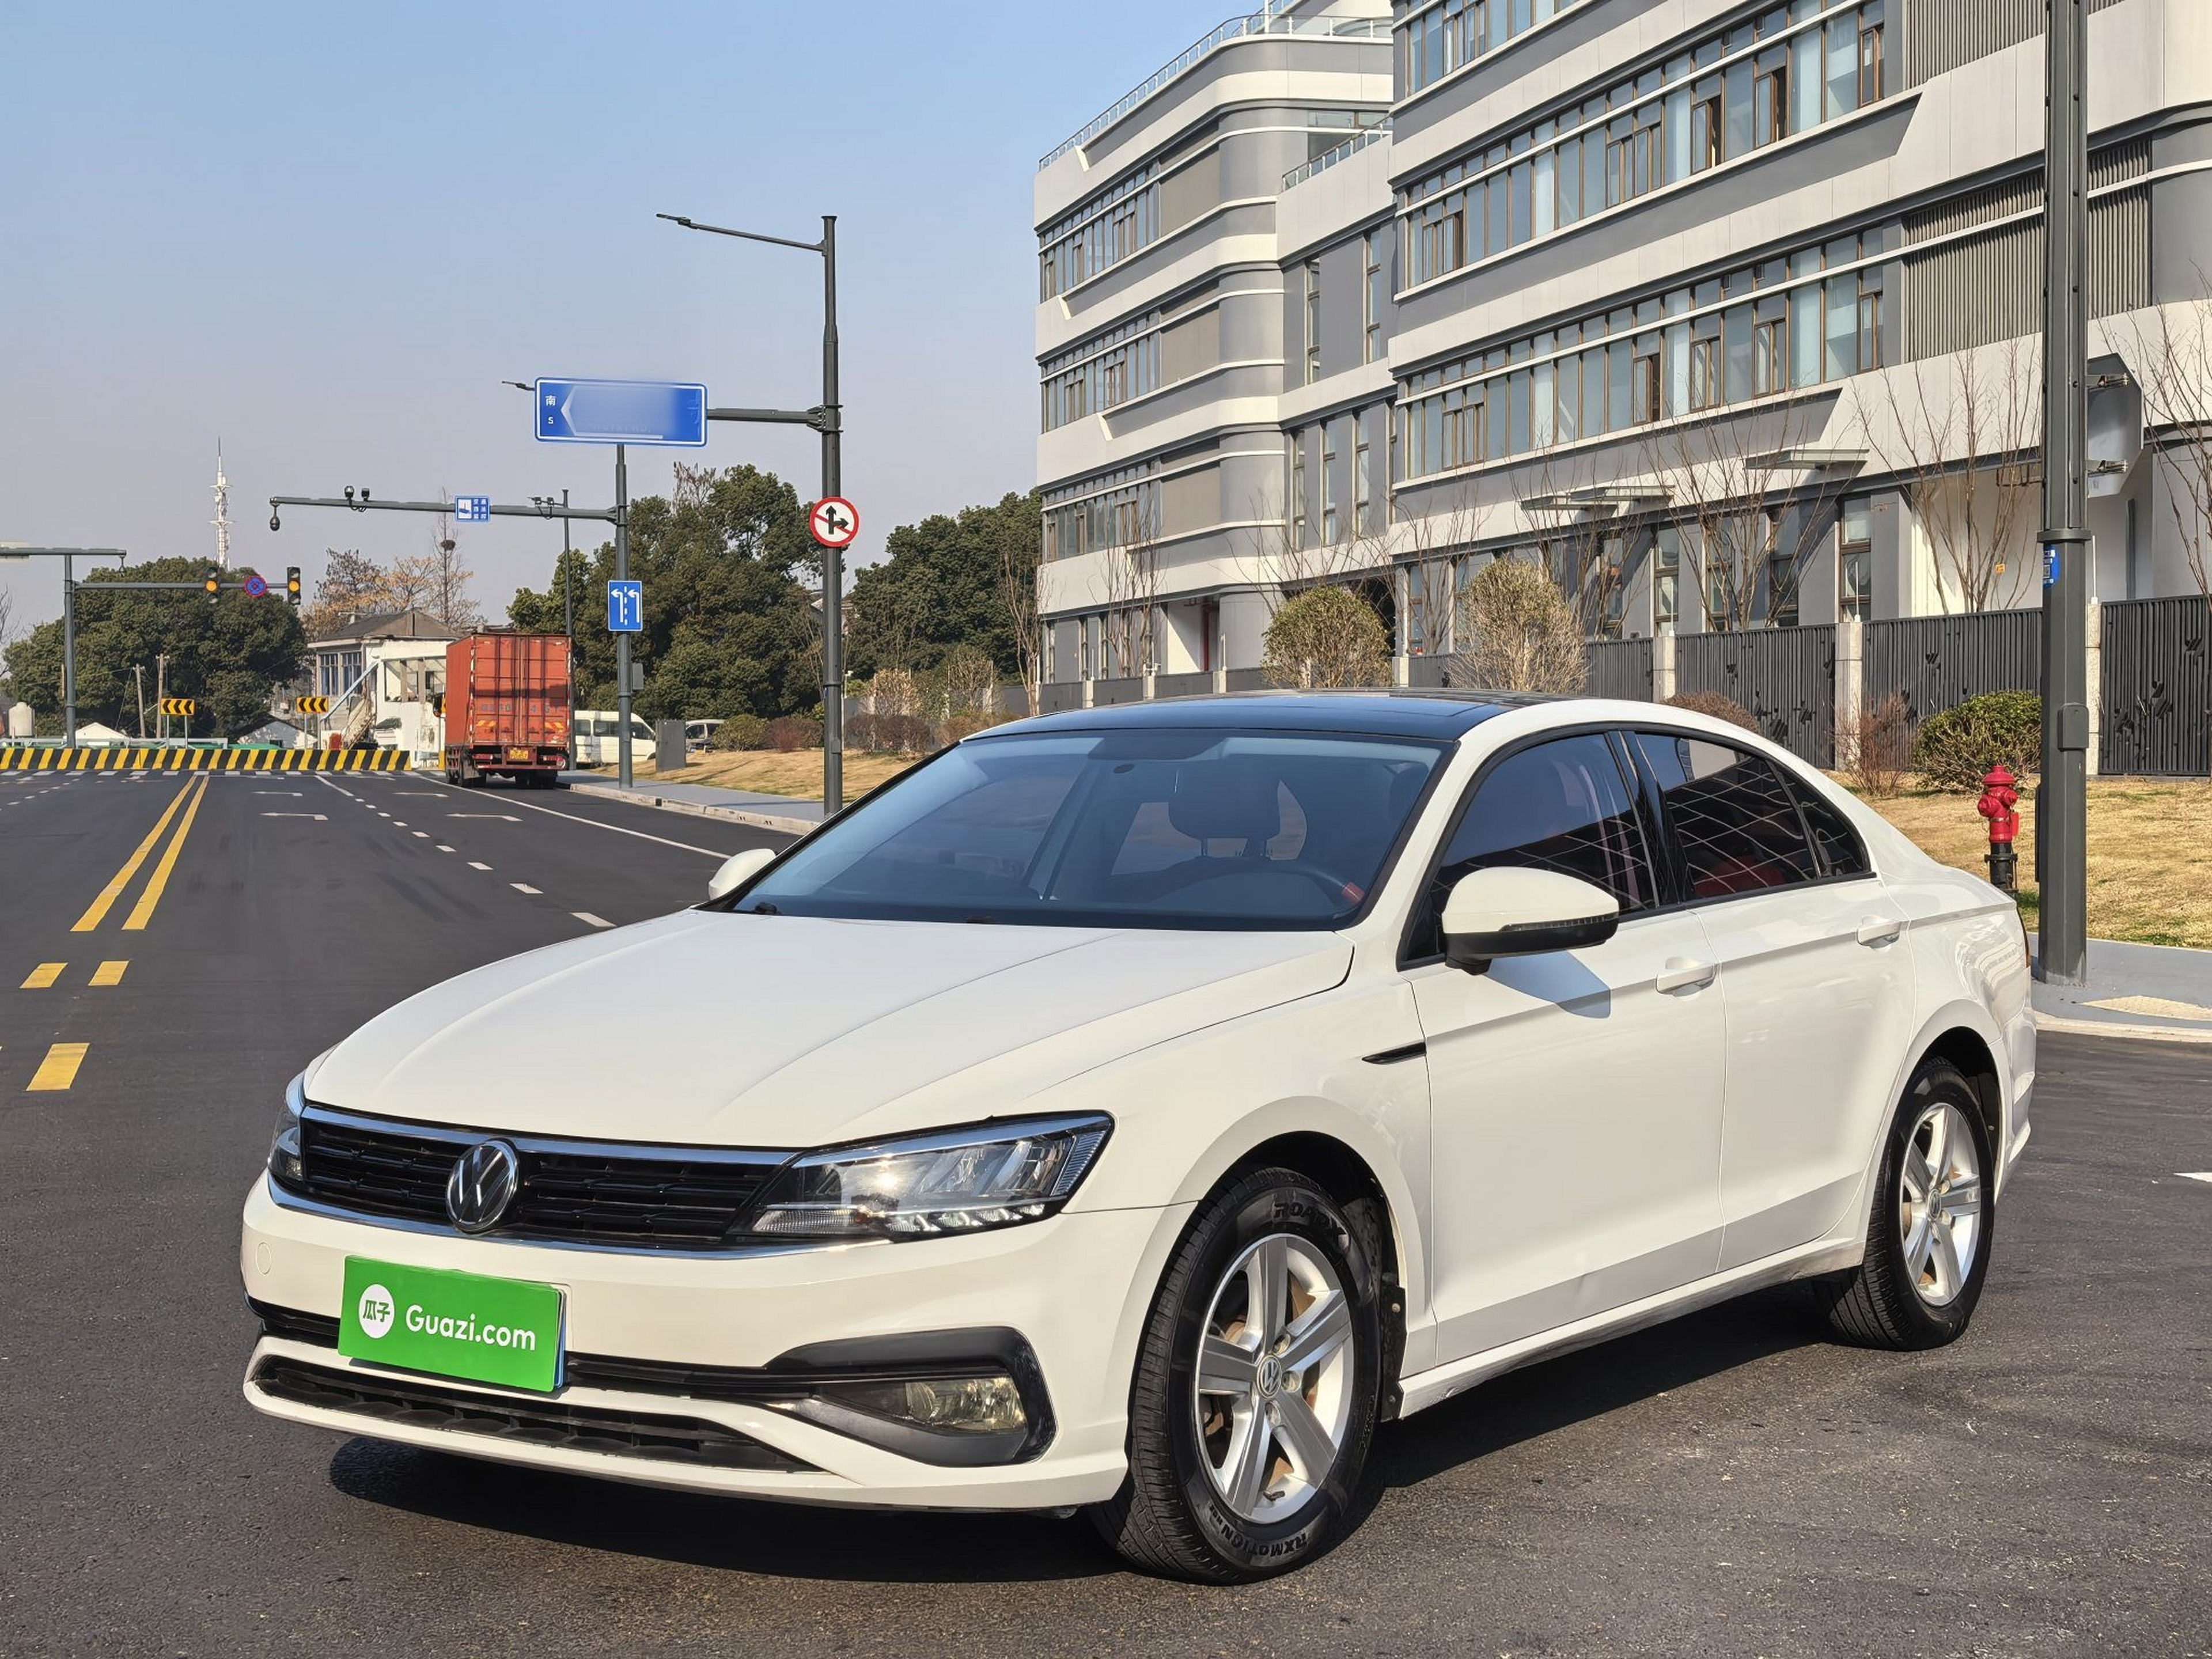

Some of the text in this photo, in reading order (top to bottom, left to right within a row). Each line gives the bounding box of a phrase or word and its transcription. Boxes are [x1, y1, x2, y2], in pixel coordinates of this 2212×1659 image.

[546, 395, 556, 407] 南
[548, 416, 554, 425] S
[362, 1299, 391, 1323] 瓜子
[406, 1304, 536, 1351] Guazi.com
